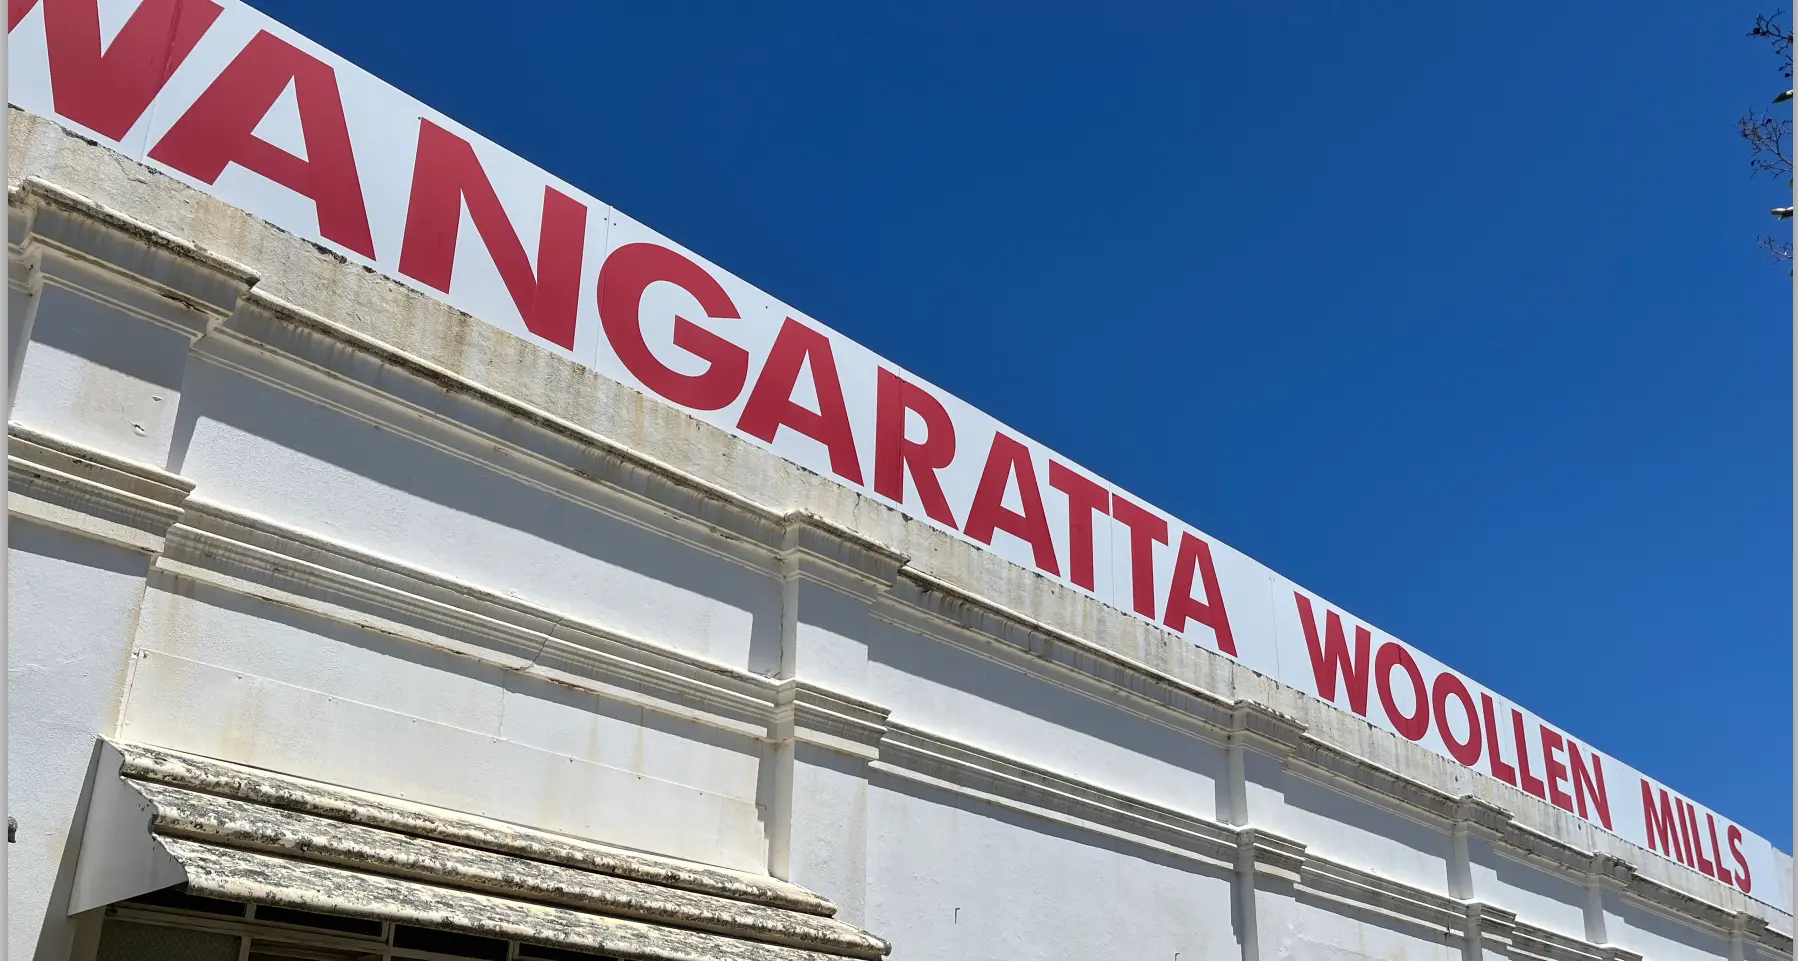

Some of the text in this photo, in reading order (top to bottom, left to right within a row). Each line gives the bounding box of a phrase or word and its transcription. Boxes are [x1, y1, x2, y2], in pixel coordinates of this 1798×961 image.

[8, 0, 1751, 894] WANGARATTA WOOLLEN MILLS
